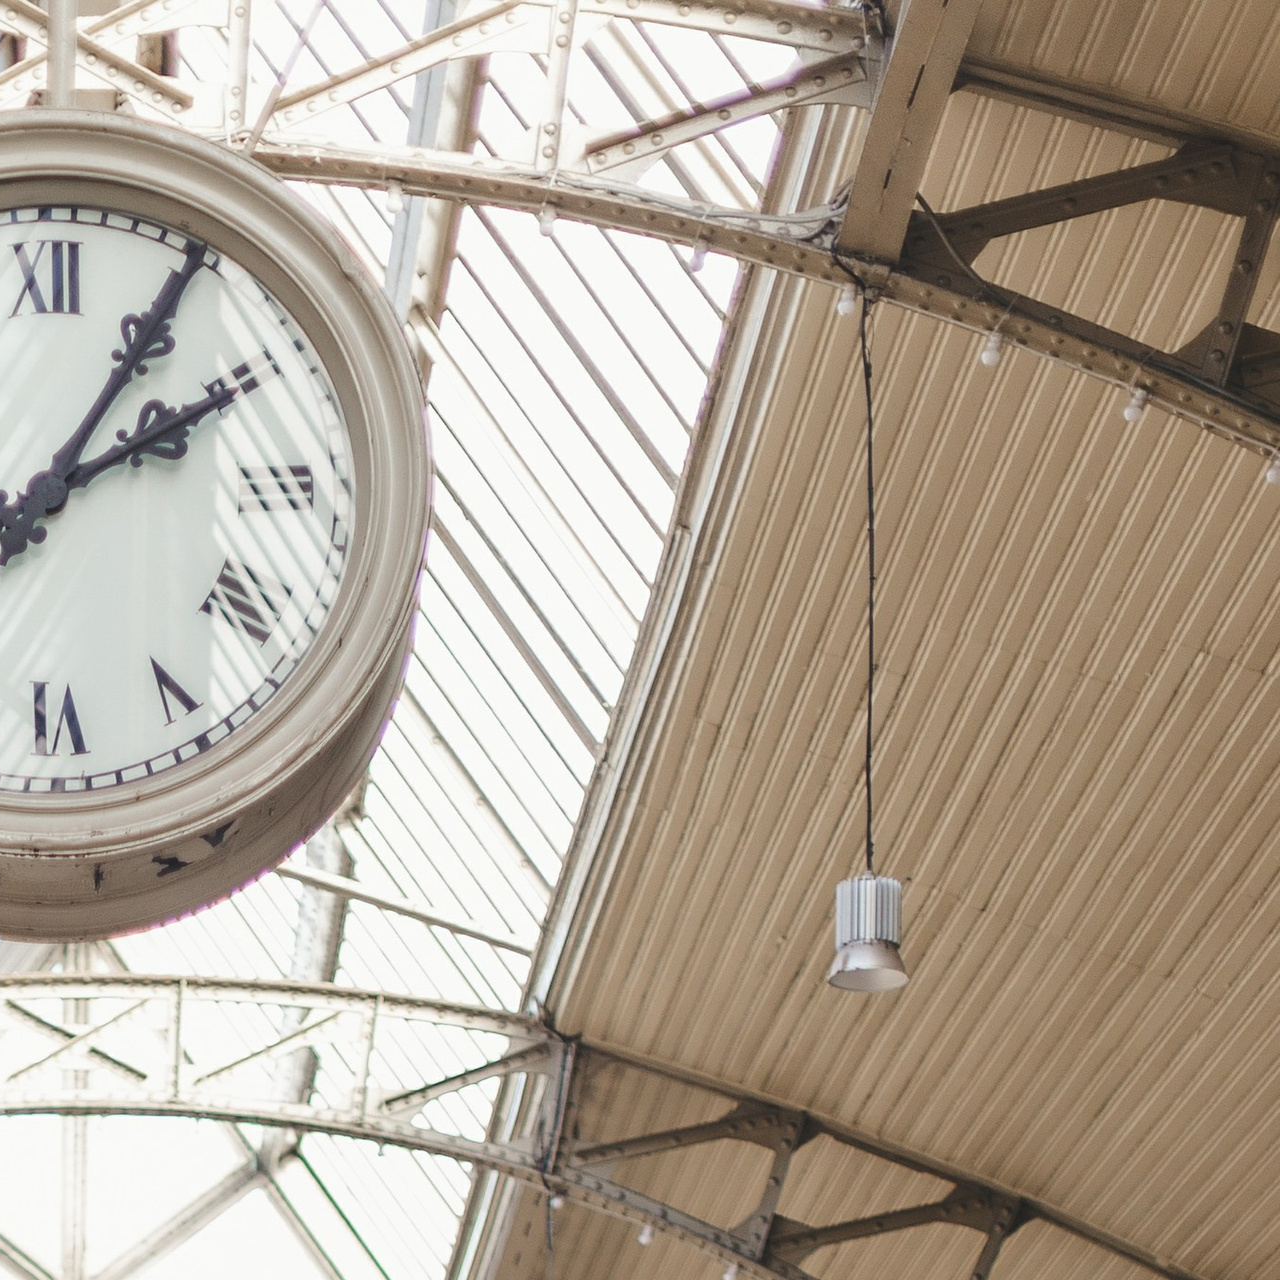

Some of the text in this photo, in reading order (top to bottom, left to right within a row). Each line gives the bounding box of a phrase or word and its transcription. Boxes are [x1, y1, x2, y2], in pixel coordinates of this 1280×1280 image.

[7, 239, 84, 317] XII
[236, 459, 314, 517] III
[29, 680, 91, 757] VI
[149, 655, 205, 726] V
